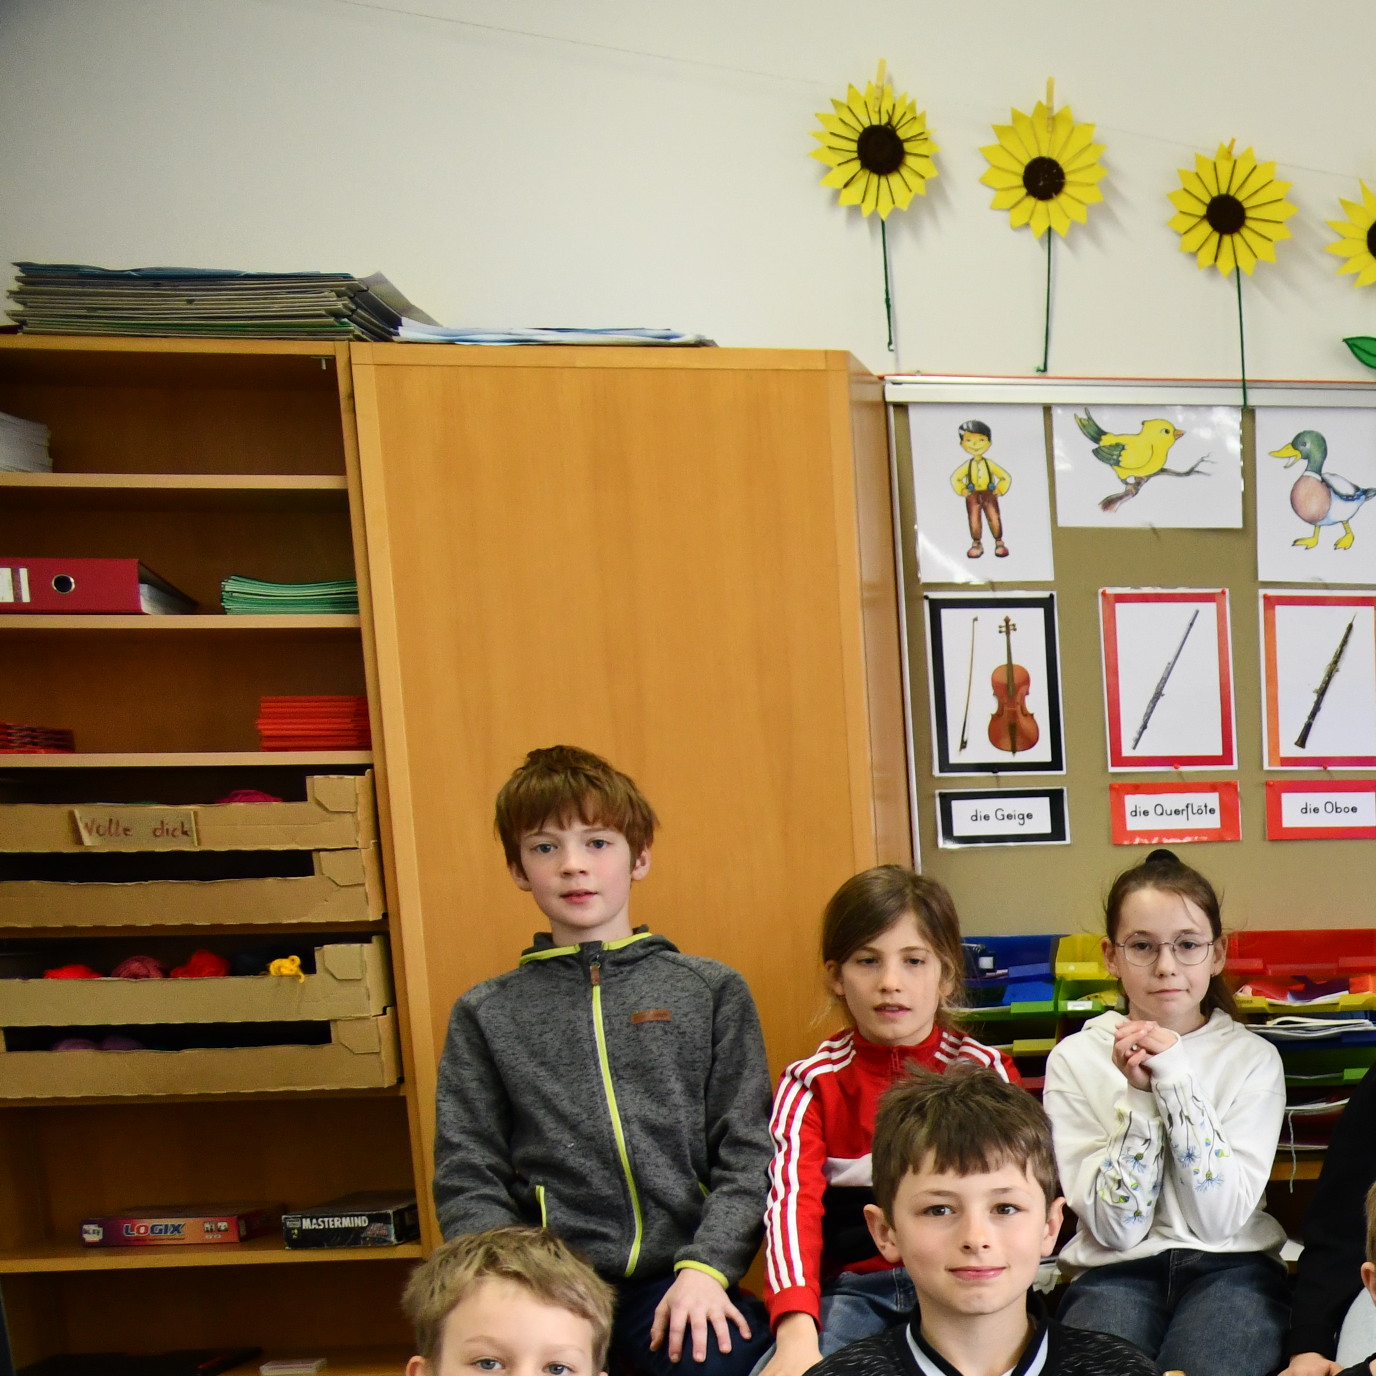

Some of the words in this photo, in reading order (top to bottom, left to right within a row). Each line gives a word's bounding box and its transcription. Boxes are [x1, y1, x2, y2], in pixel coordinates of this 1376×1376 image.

[1129, 804, 1150, 818] die
[1153, 803, 1217, 822] Querflöte
[1300, 801, 1320, 814] die
[1323, 801, 1359, 815] Oboe
[970, 808, 990, 822] die
[994, 808, 1034, 826] Geige
[123, 1222, 186, 1237] LOGIX
[302, 1215, 369, 1230] MASTERMIND
